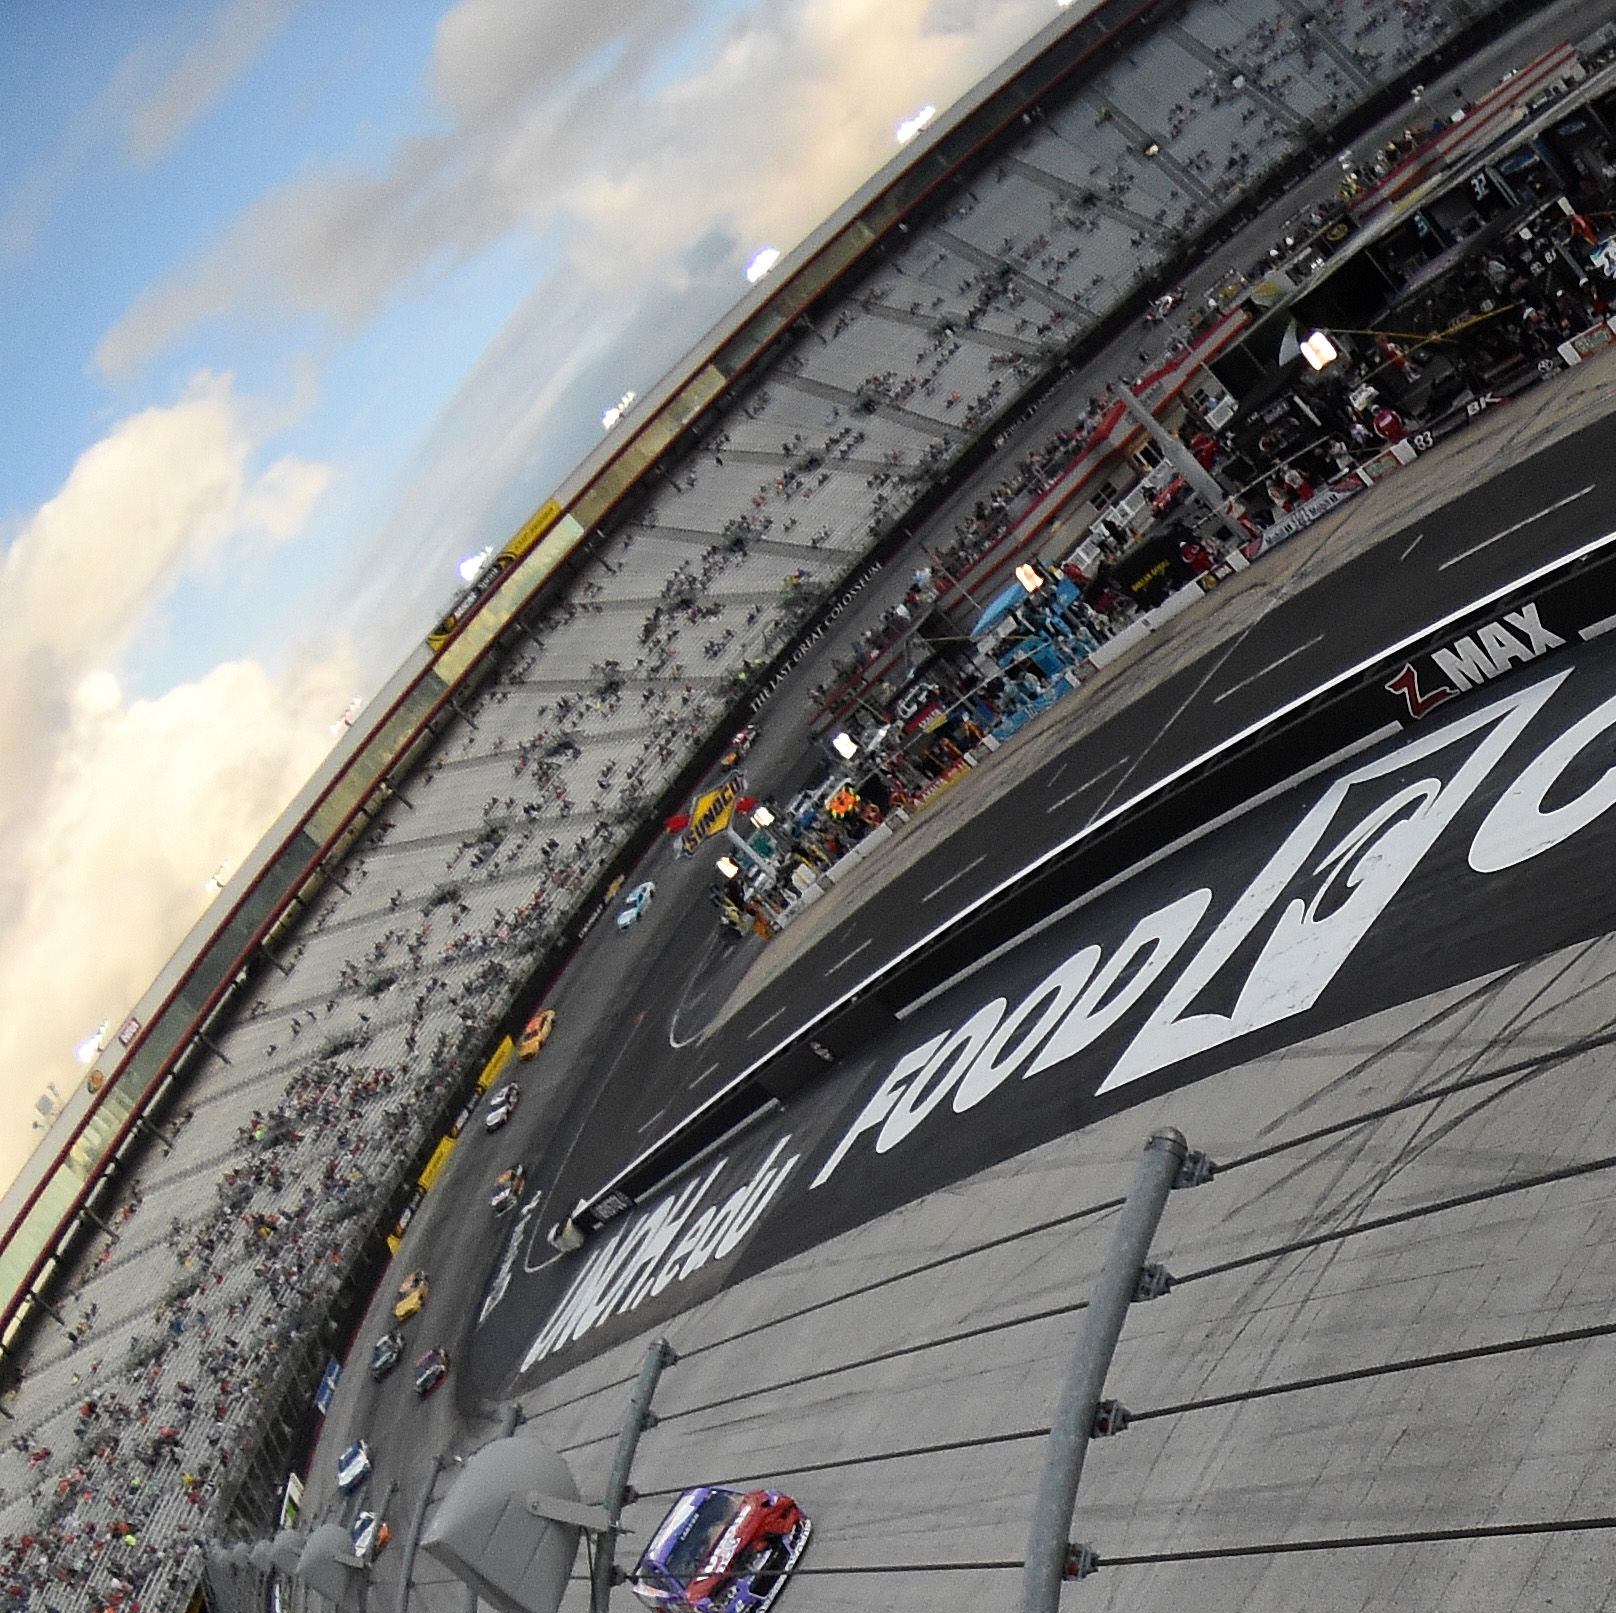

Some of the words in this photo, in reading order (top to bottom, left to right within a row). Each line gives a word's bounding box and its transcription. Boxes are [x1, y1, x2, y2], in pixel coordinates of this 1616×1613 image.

[1467, 391, 1502, 416] BK
[1414, 431, 1434, 451] 83
[792, 626, 826, 663] GREAT
[824, 561, 883, 627] COLOSSEUM
[810, 888, 1213, 1190] FOOD
